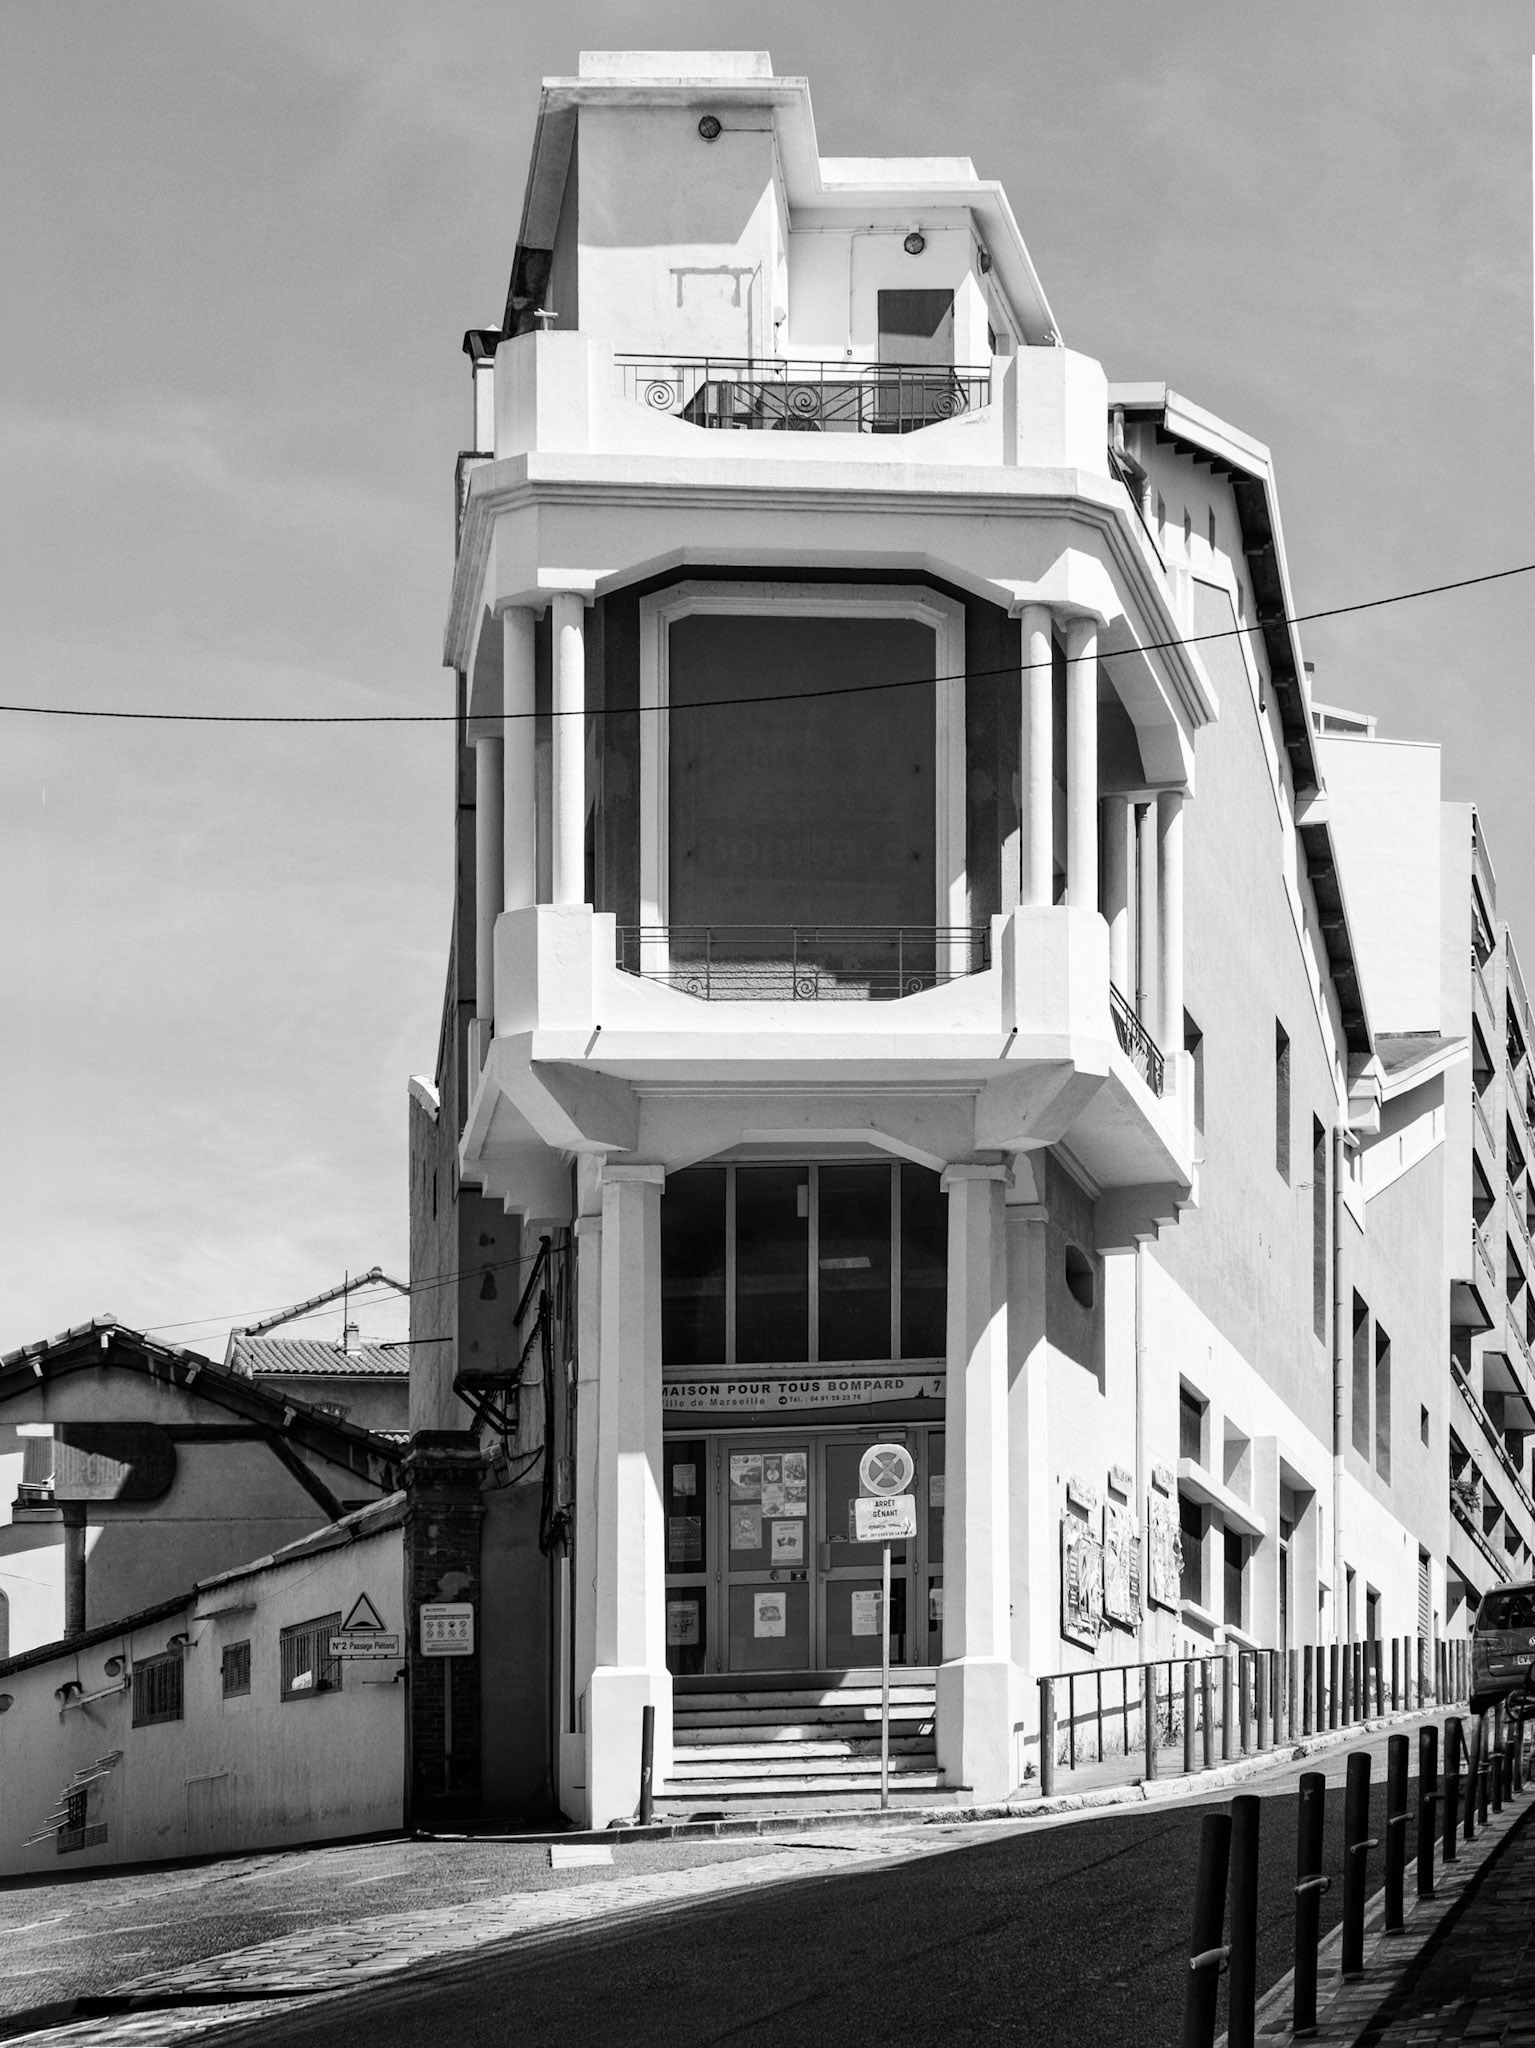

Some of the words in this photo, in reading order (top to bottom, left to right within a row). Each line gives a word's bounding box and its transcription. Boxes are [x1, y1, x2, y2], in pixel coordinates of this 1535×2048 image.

[727, 1384, 771, 1395] POUR
[778, 1382, 820, 1393] TOUS
[827, 1379, 904, 1391] BOMPARD
[662, 1399, 685, 1408] ille
[690, 1399, 704, 1407] de
[710, 1397, 765, 1407] Marseille
[875, 1499, 895, 1507] ARRÊT
[873, 1509, 898, 1518] GÊNANT
[349, 1641, 373, 1652] Passage
